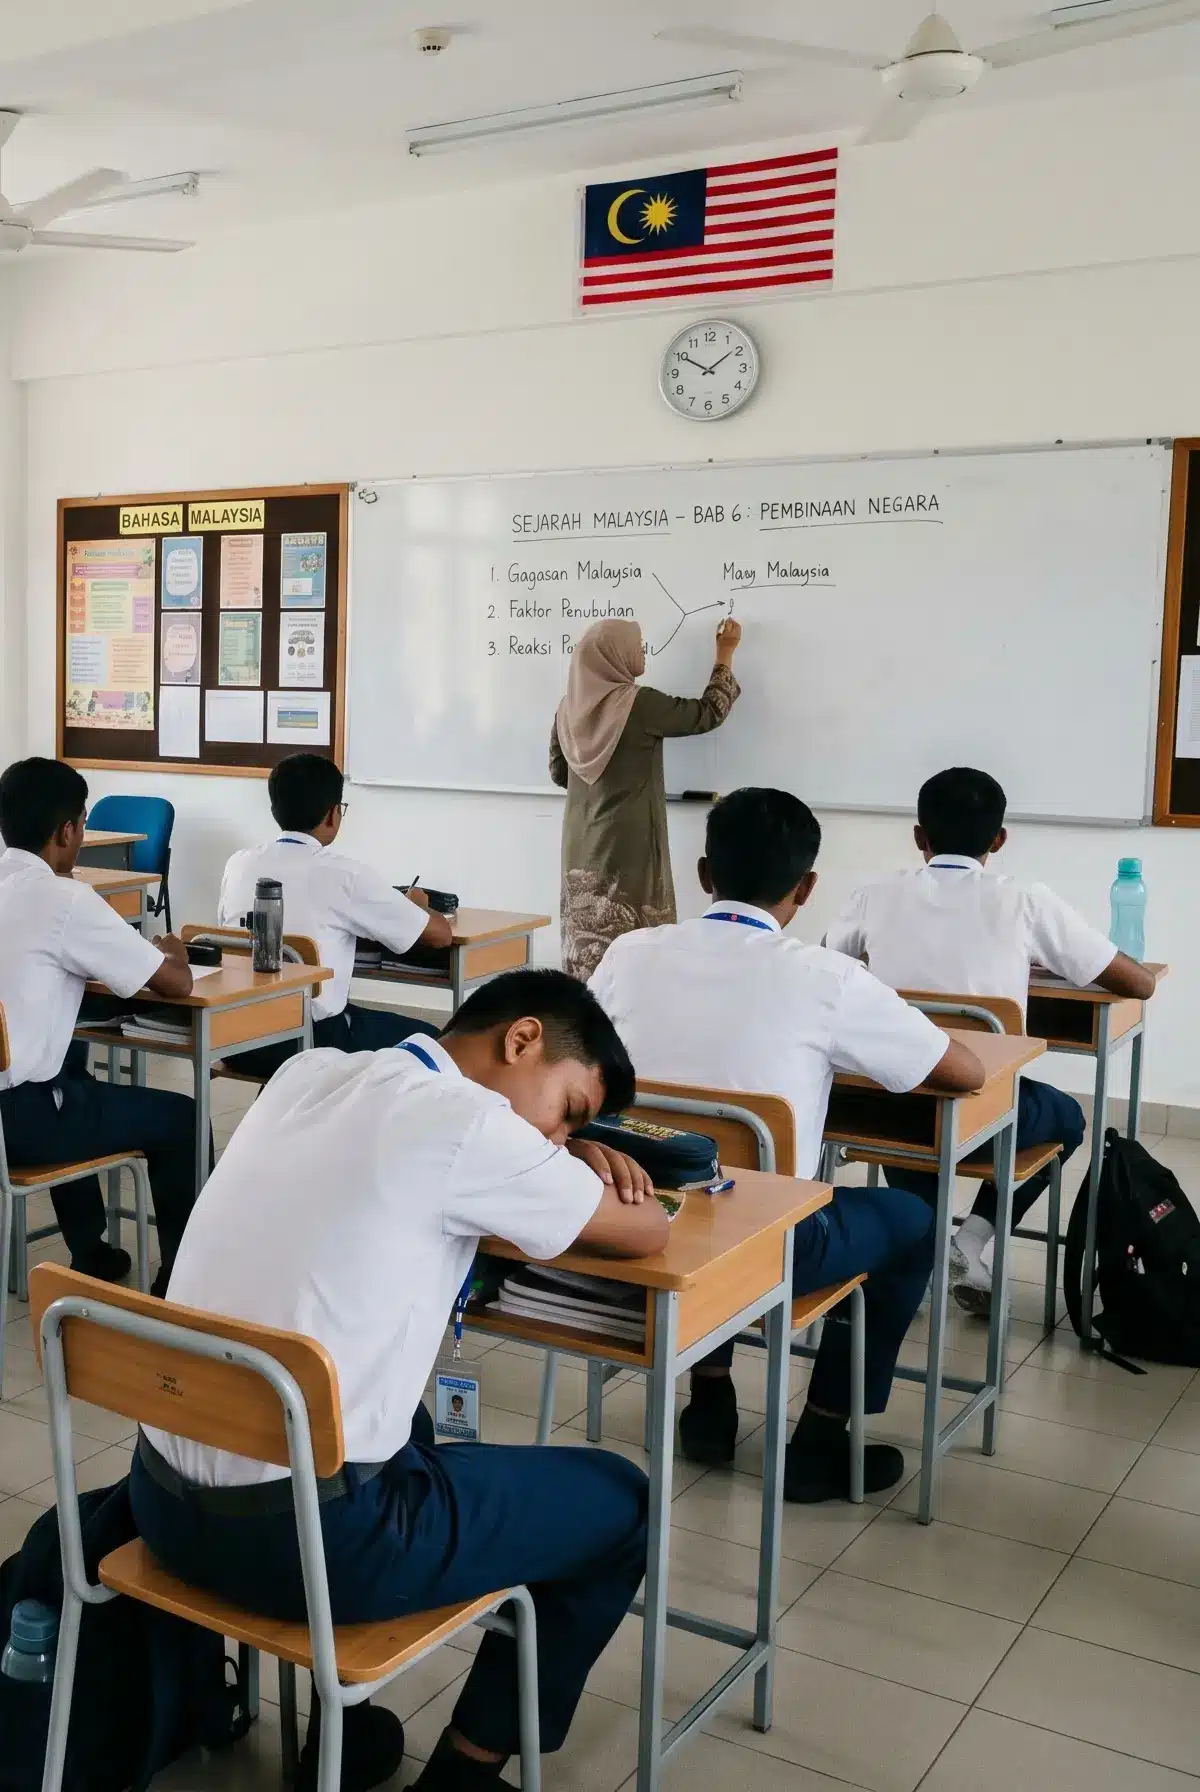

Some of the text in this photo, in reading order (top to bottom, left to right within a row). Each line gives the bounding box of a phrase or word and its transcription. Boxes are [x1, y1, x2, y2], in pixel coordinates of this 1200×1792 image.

[704, 332, 716, 342] 12
[726, 335, 730, 344] 1
[688, 339, 698, 348] 11
[734, 346, 743, 356] 2
[676, 352, 688, 362] 10
[739, 363, 747, 373] 3
[671, 369, 679, 378] 9
[676, 385, 684, 395] 8
[734, 381, 742, 390] 4
[688, 397, 696, 407] 7
[722, 394, 730, 404] 5
[704, 401, 712, 410] 6
[122, 508, 262, 528] BAHASA MALAYSIA
[511, 513, 581, 533] SEJARAH
[593, 509, 669, 529] MALAYSIA
[693, 505, 725, 524] BAB
[760, 499, 856, 520] PEMBINAAN
[868, 494, 940, 515] NEGARA
[490, 560, 642, 591] 1. Gagasan Malaysia
[767, 560, 830, 587] Malaysia
[487, 598, 635, 619] 2. Faktor Penubuhan
[487, 641, 500, 656] 3.
[509, 635, 552, 656] Reaksi
